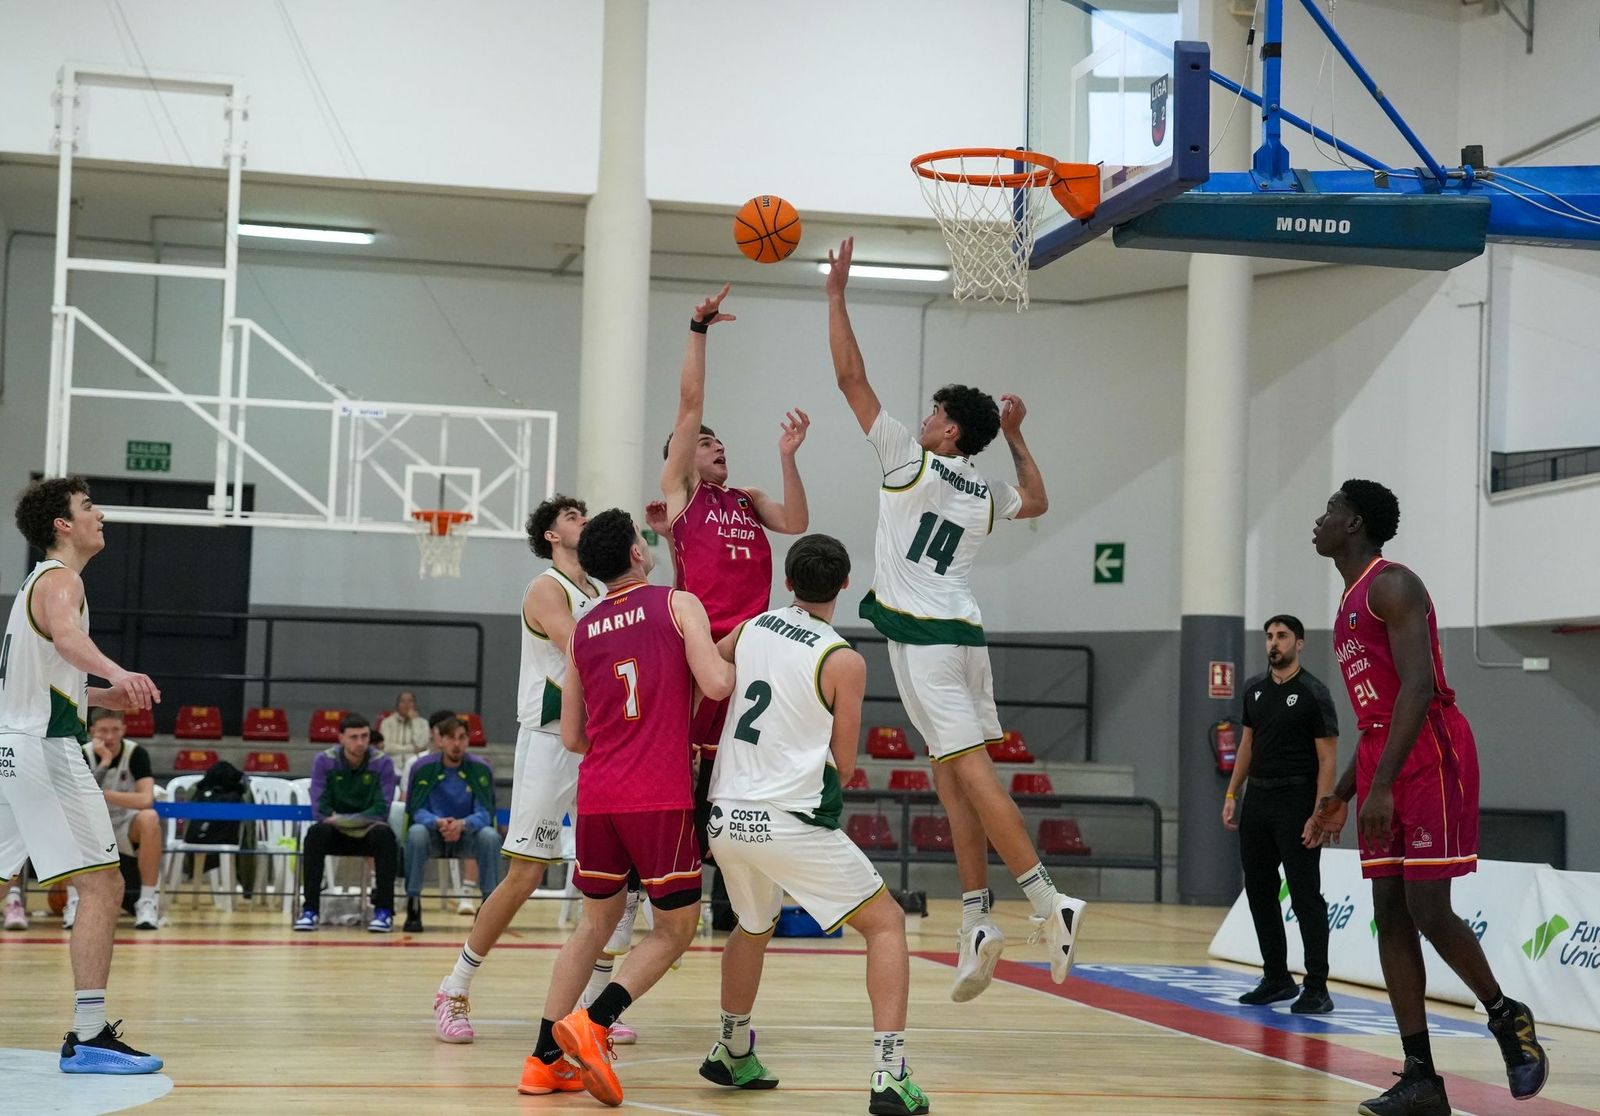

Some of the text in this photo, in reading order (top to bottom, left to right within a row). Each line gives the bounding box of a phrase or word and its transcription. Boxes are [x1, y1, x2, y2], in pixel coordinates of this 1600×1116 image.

[1151, 79, 1168, 102] LIGA
[1276, 216, 1351, 234] MONDO
[726, 543, 751, 560] 77
[905, 511, 966, 577] 14
[587, 606, 646, 639] MARVA
[754, 614, 822, 648] MARTÍNEZ
[614, 658, 640, 720] 1
[1354, 680, 1379, 707] 24
[734, 680, 772, 746] 2
[729, 821, 771, 833] DEL SOL
[731, 808, 771, 822] COSTA
[729, 831, 773, 843] MÁLAGA
